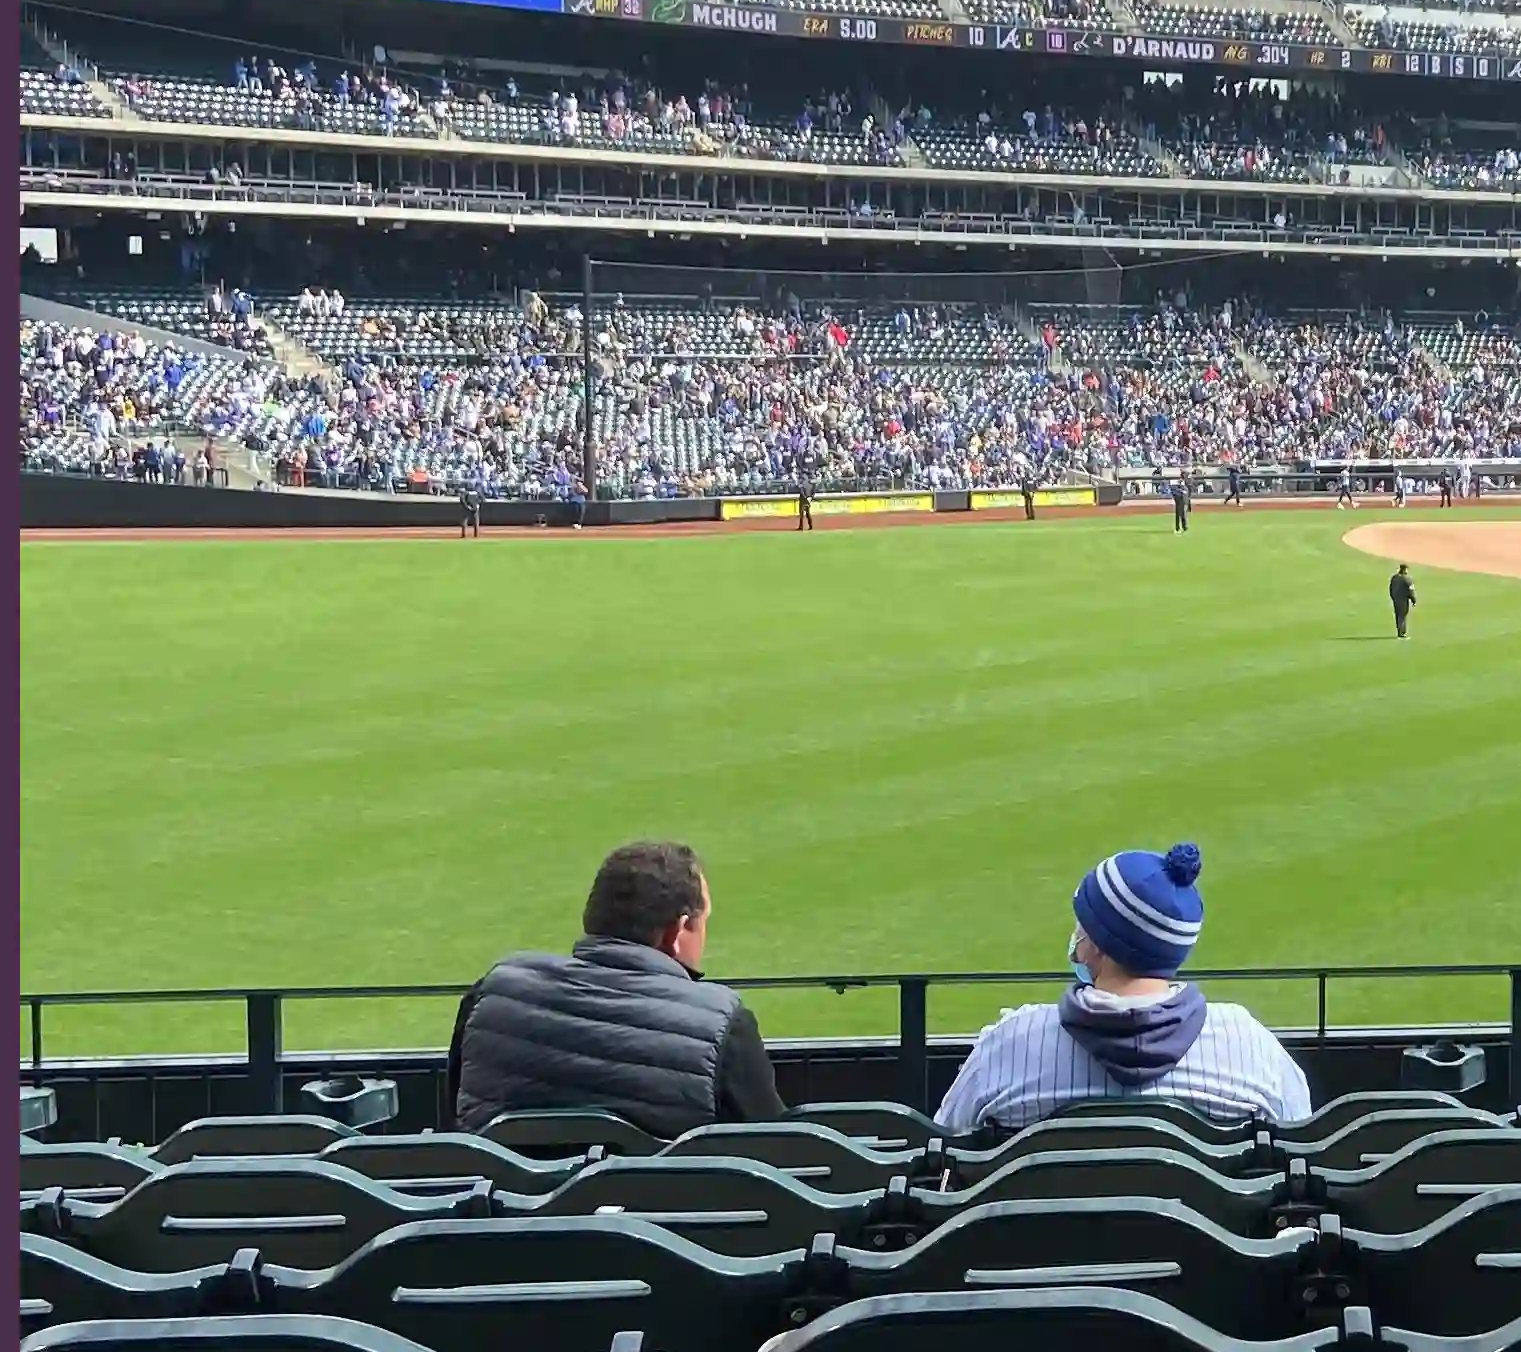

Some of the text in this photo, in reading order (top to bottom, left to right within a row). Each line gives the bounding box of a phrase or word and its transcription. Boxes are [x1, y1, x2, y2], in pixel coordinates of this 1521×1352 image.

[803, 18, 828, 33] ERA
[1113, 37, 1214, 60] D'ARNAUD
[1257, 45, 1289, 65] .304
[1310, 51, 1325, 64] HR
[1341, 51, 1351, 67] 2
[1431, 55, 1441, 74] B
[1455, 57, 1465, 75] S
